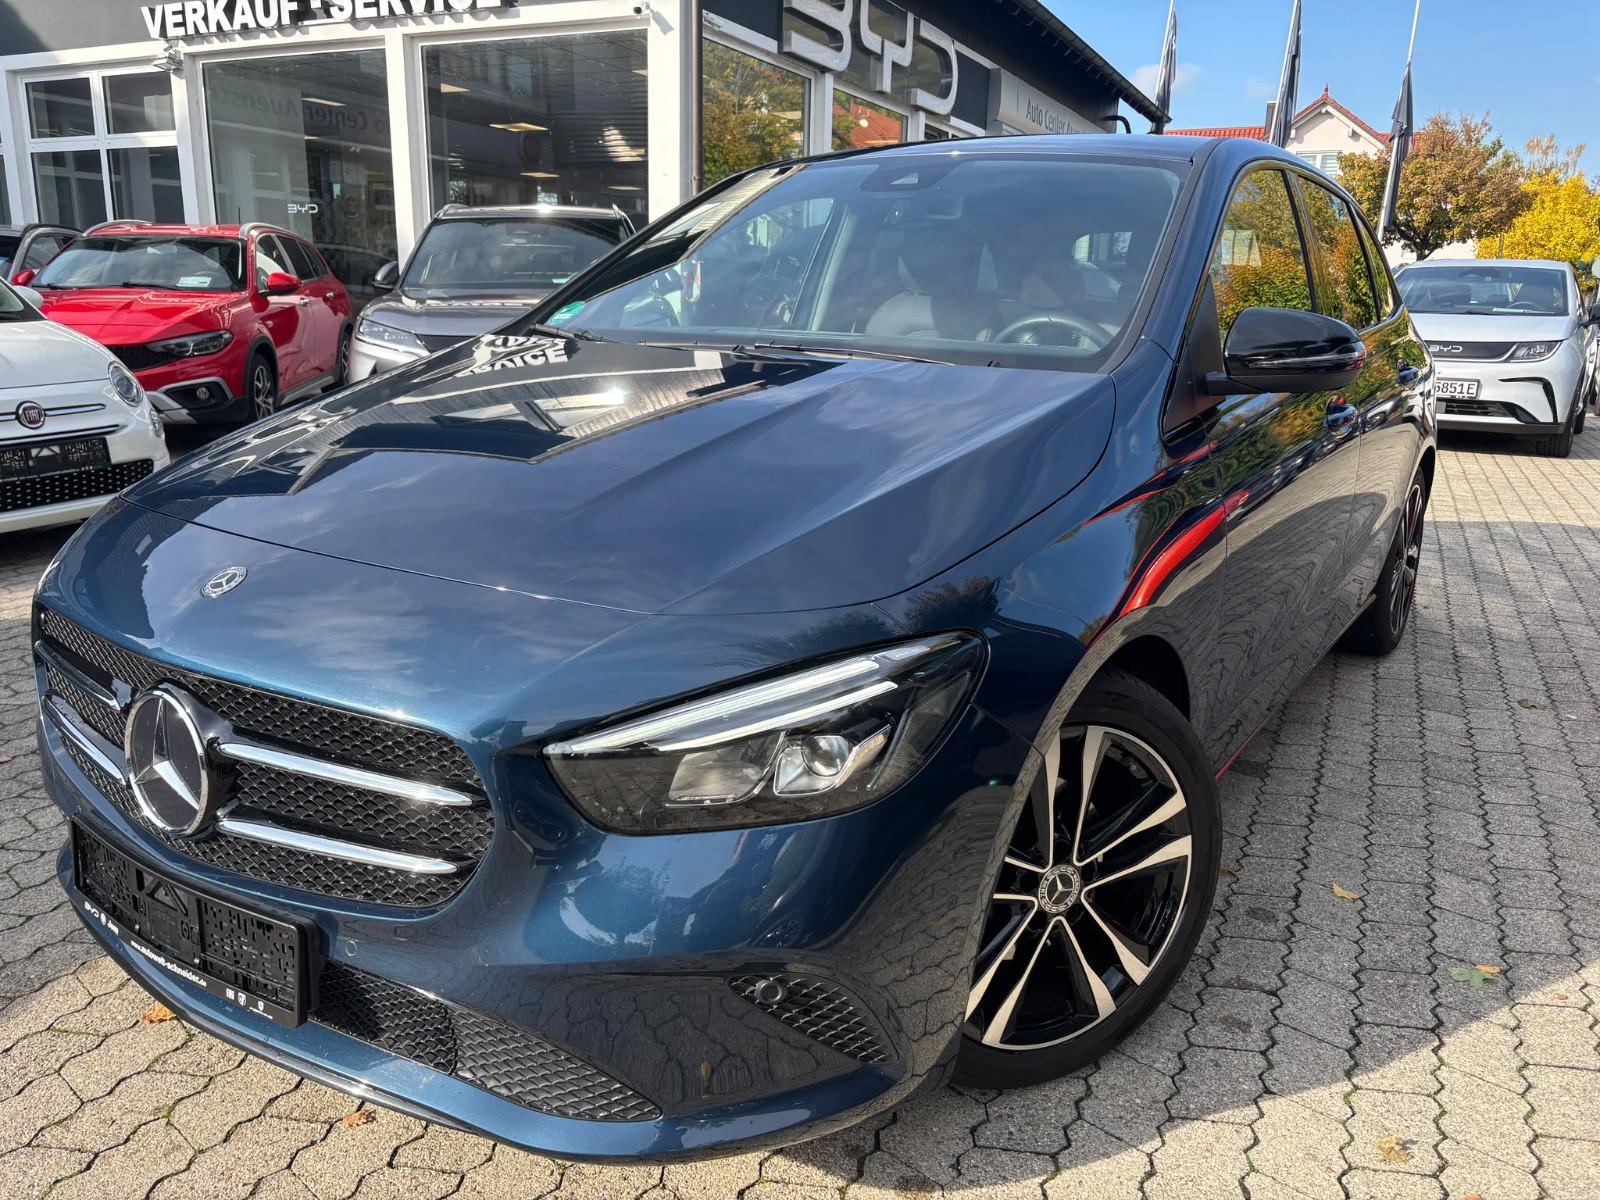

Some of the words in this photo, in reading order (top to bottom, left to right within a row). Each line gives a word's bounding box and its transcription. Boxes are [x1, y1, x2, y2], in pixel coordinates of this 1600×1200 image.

[141, 0, 299, 39] VERKAUF
[329, 0, 502, 20] SERV
[783, 0, 959, 115] BYD
[1026, 98, 1043, 126] Auto
[287, 203, 319, 214] BYD
[1429, 344, 1463, 352] BYD
[25, 409, 40, 422] FIAT
